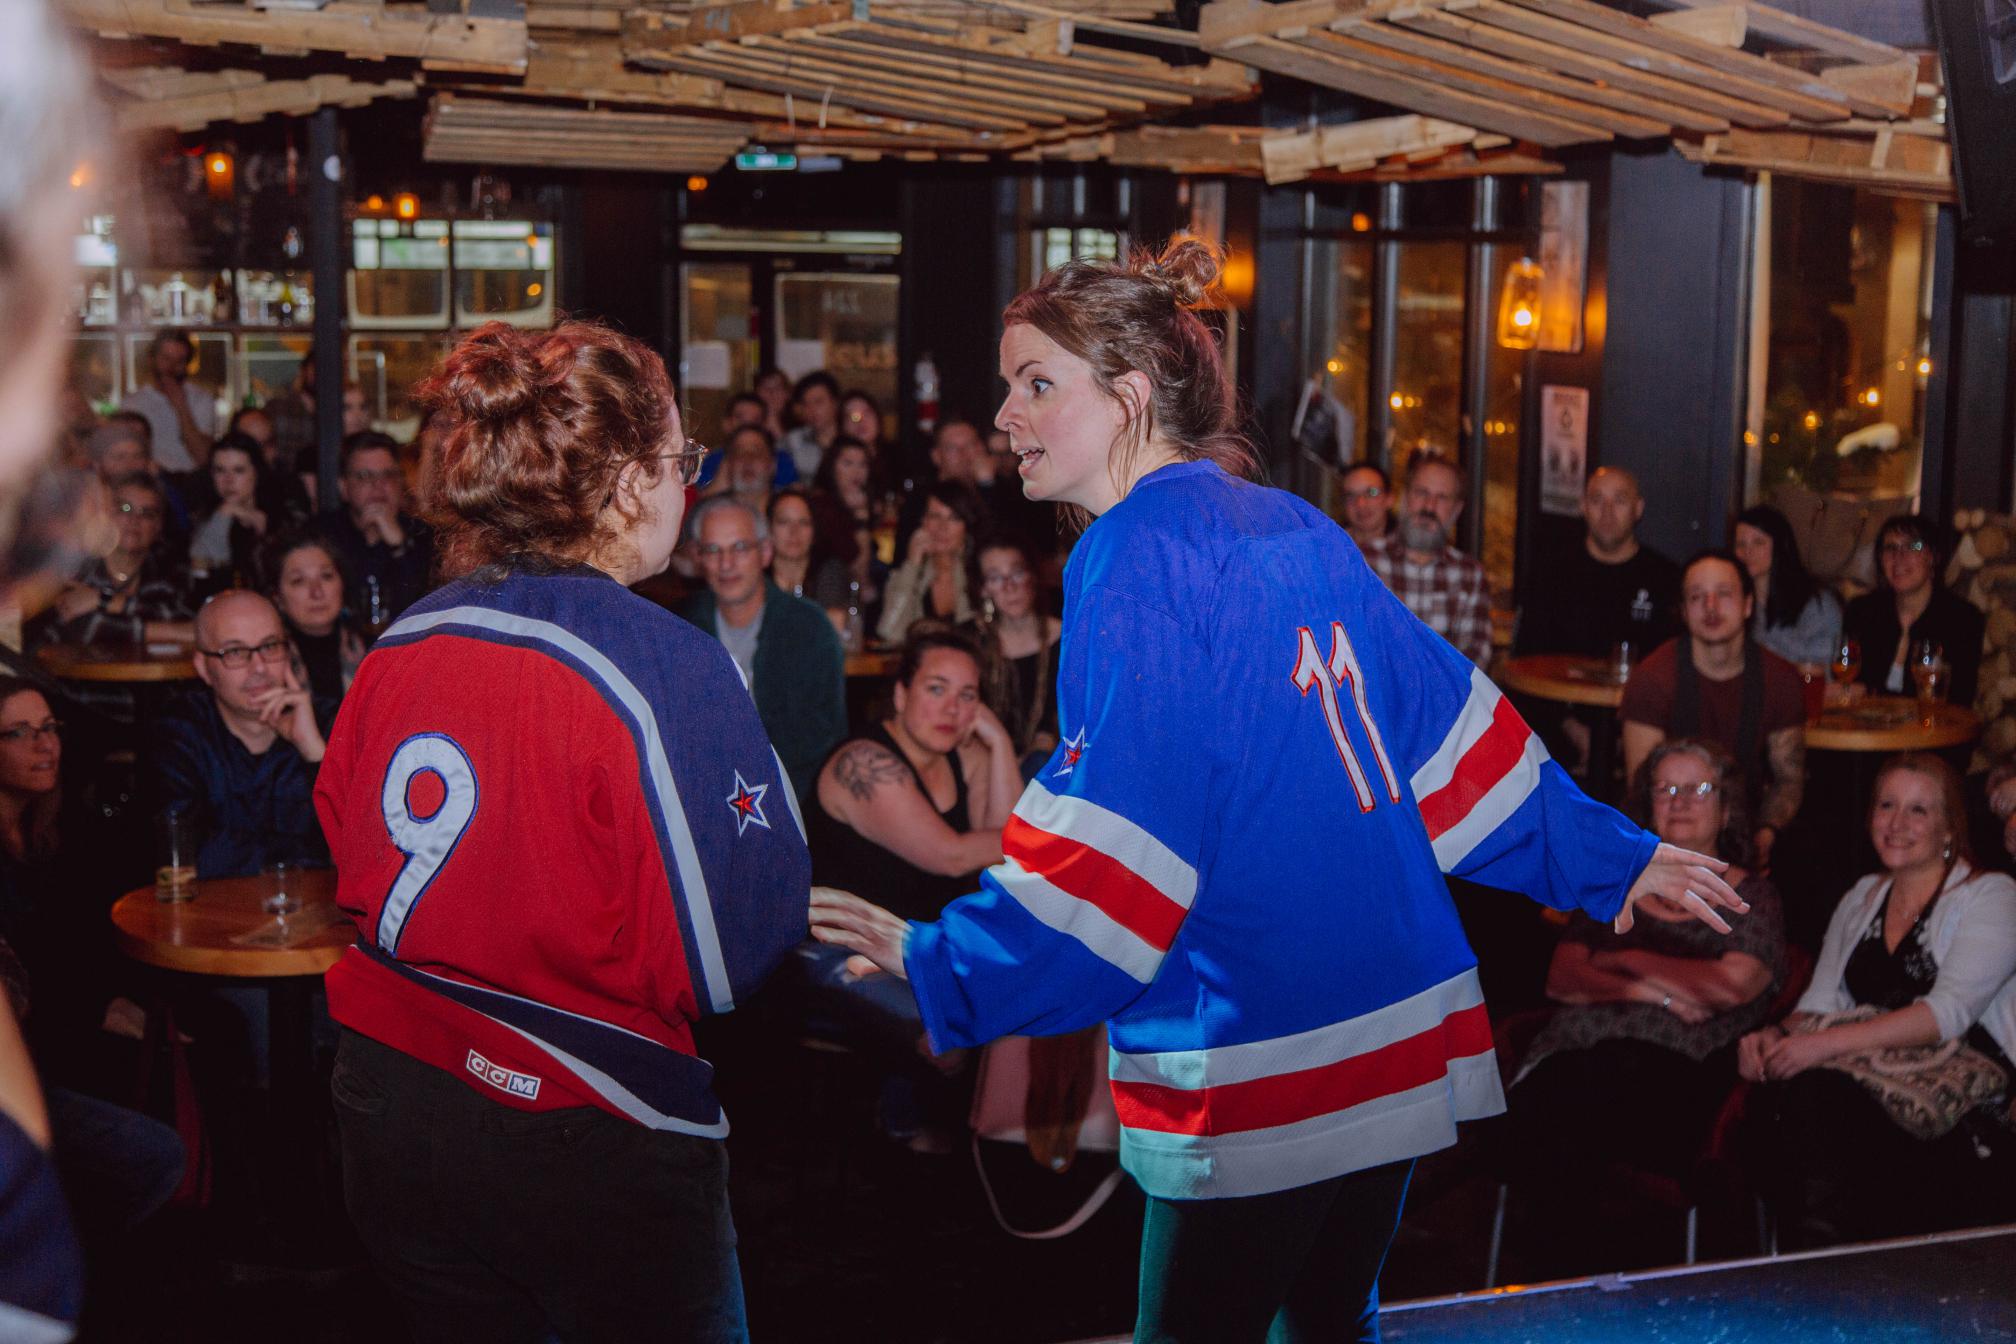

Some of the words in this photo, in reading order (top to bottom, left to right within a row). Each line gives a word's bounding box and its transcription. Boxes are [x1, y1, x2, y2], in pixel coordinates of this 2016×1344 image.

[1290, 621, 1401, 813] 11
[375, 732, 480, 957] 9
[470, 1057, 536, 1095] CCM
